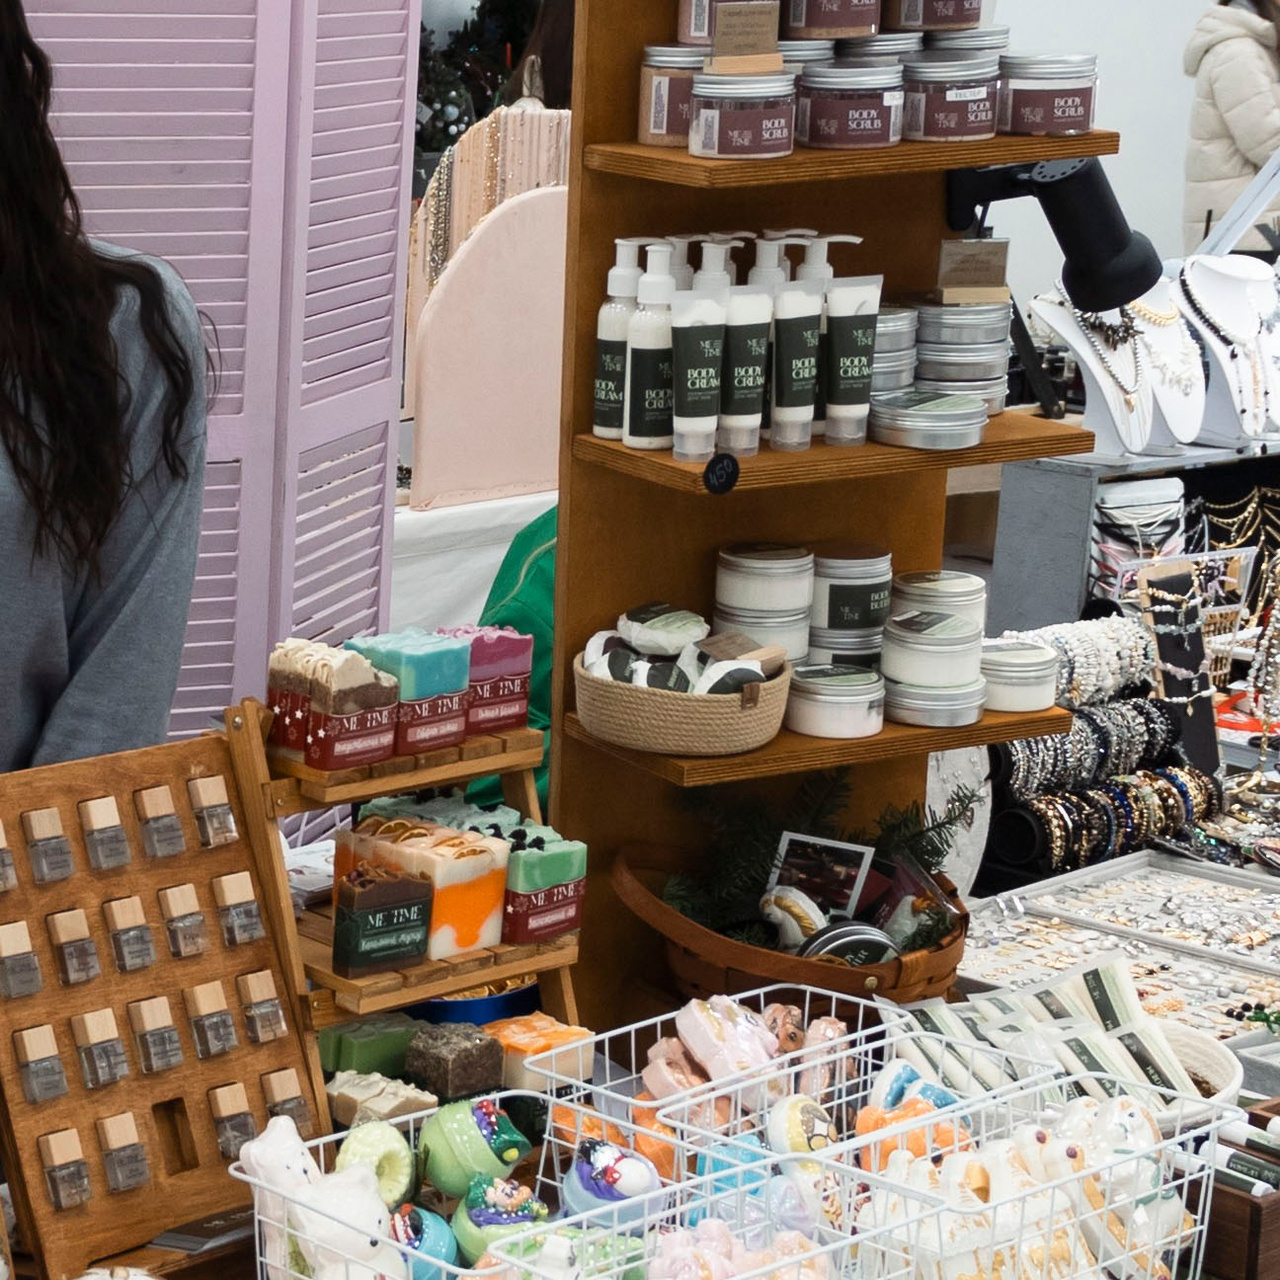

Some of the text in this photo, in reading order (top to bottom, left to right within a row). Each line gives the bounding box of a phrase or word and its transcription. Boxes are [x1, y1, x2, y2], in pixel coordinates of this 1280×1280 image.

[1054, 97, 1081, 107] BODY
[849, 109, 878, 119] BODY
[762, 119, 786, 129] BODY
[848, 120, 882, 129] SCRUB
[761, 130, 789, 140] SCRUB
[840, 357, 868, 367] BODY
[687, 368, 717, 378] BODY
[734, 366, 762, 376] BODY
[476, 678, 524, 698] ME TIME
[414, 702, 432, 718] ME
[436, 695, 462, 714] TIME
[343, 709, 392, 731] ME TIME
[530, 883, 578, 908] ME TIME
[367, 904, 423, 929] ME TIME
